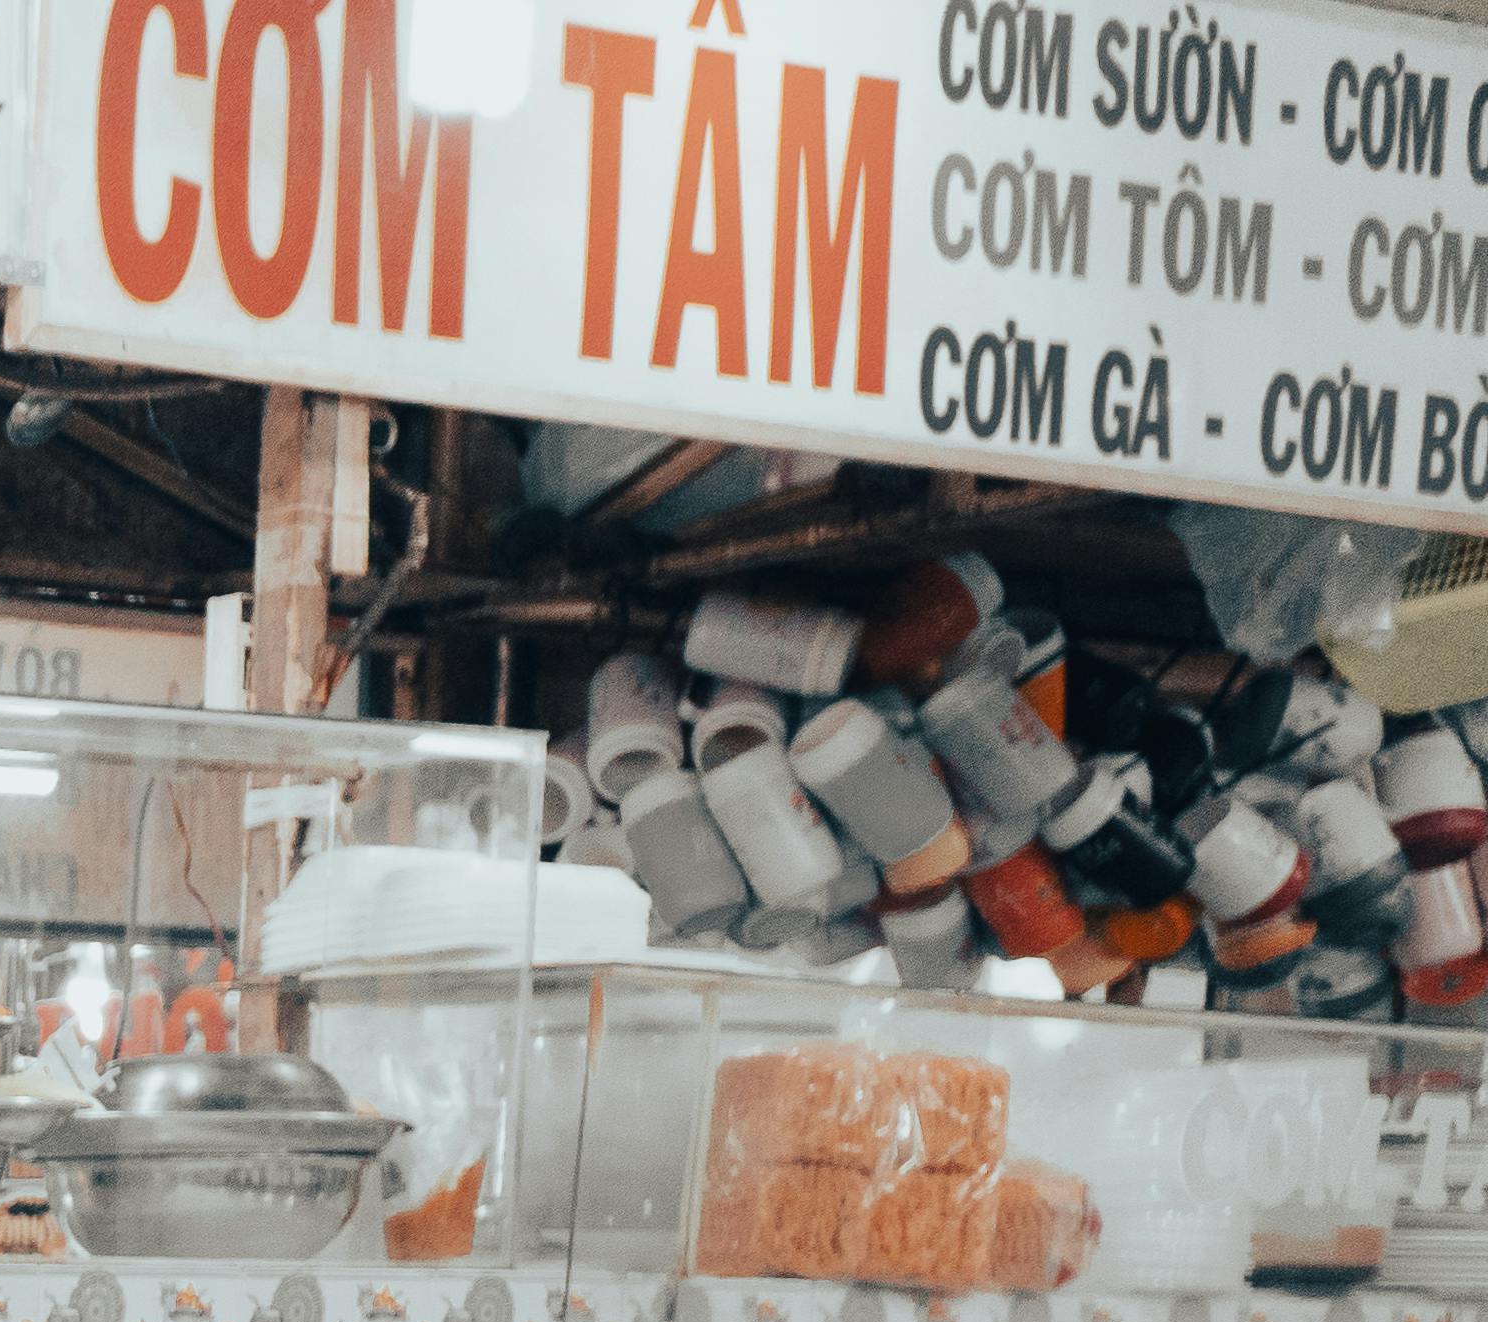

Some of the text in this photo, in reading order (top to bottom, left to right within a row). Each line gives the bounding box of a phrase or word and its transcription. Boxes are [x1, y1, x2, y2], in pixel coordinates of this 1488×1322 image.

[938, 0, 1074, 118] CƠM
[1093, 3, 1258, 146] SƯỜN
[1323, 51, 1450, 179] CƠM
[931, 149, 1092, 281] CƠM
[1119, 161, 1274, 304] TÔM
[1348, 210, 1488, 337] CƠM
[920, 318, 1069, 447] CƠM
[1092, 323, 1171, 460] GÀ
[1261, 362, 1399, 490] CƠM
